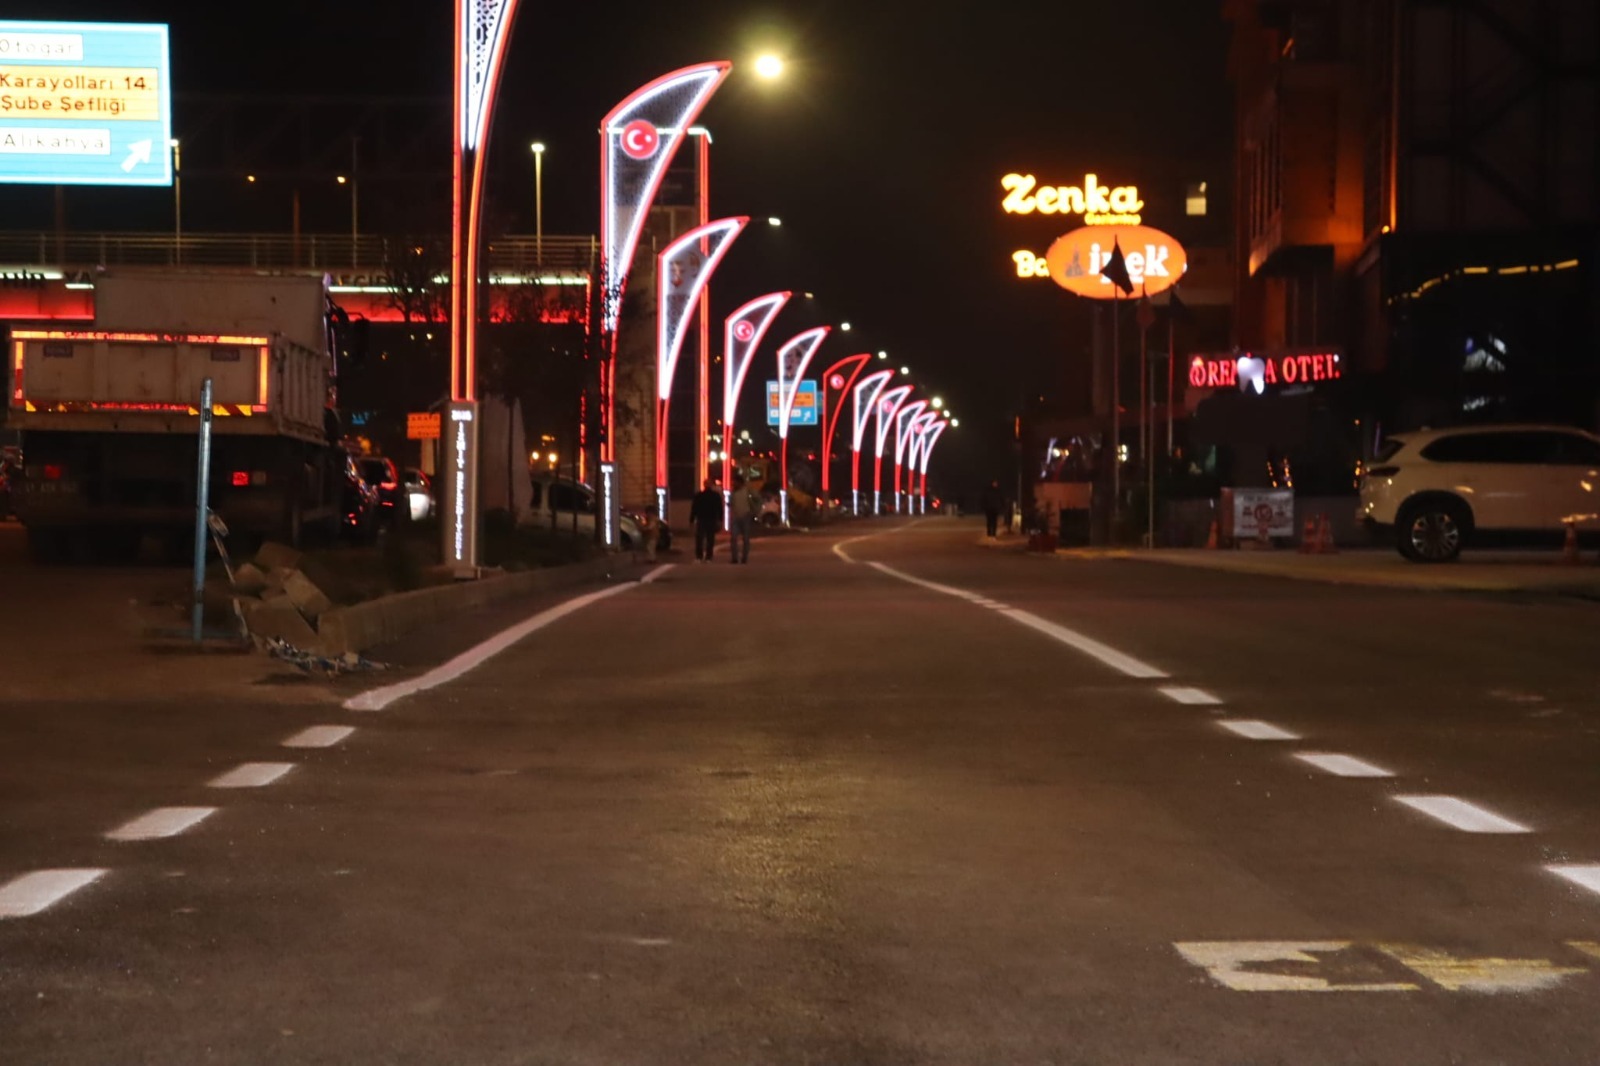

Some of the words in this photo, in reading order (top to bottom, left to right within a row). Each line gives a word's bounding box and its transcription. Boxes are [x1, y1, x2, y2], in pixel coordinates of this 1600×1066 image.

[0, 38, 73, 56] Otogar
[0, 73, 113, 92] Karayolları
[1, 95, 52, 111] Şube
[60, 97, 126, 115] Şefliği
[1001, 173, 1144, 214] Zenka
[1012, 250, 1050, 278] Ba
[1282, 353, 1341, 383] OTEL
